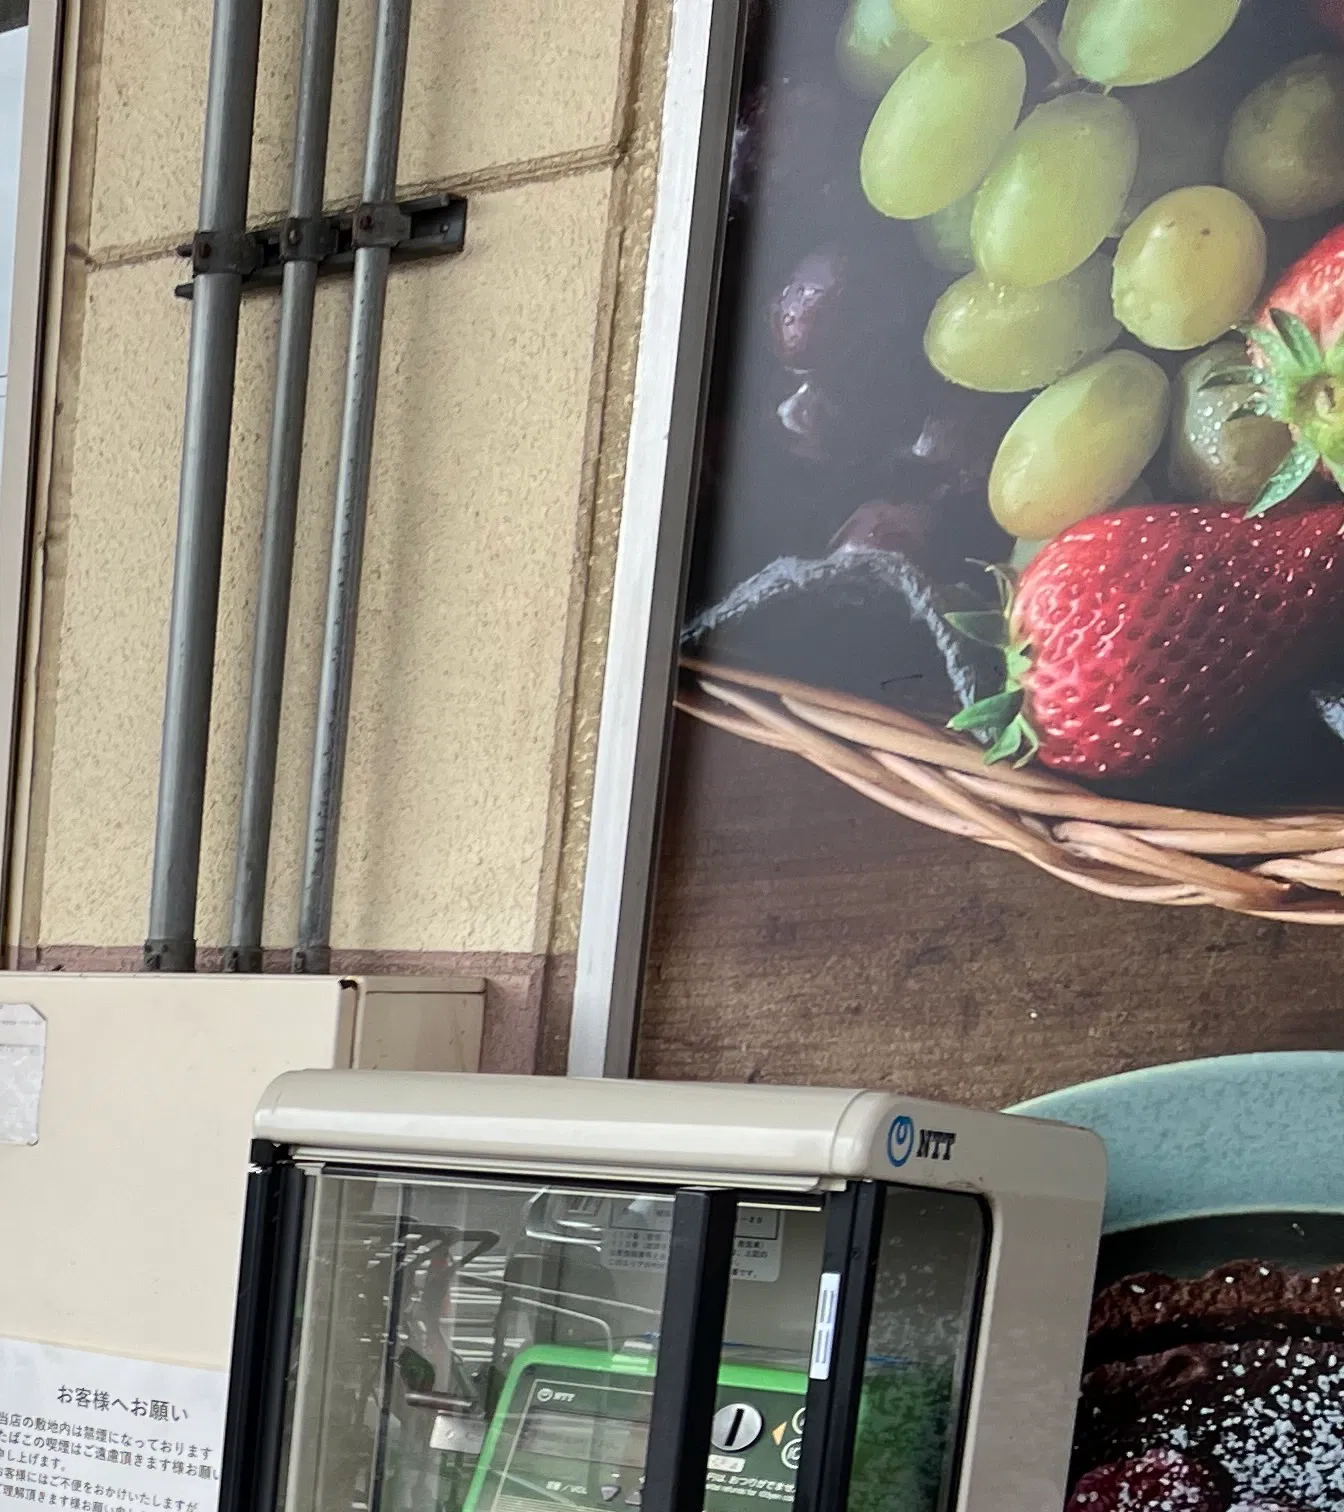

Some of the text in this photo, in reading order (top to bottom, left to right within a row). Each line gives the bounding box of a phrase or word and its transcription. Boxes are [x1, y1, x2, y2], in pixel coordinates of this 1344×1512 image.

[915, 1128, 957, 1161] NTT
[56, 1384, 189, 1422] お客様へお願い
